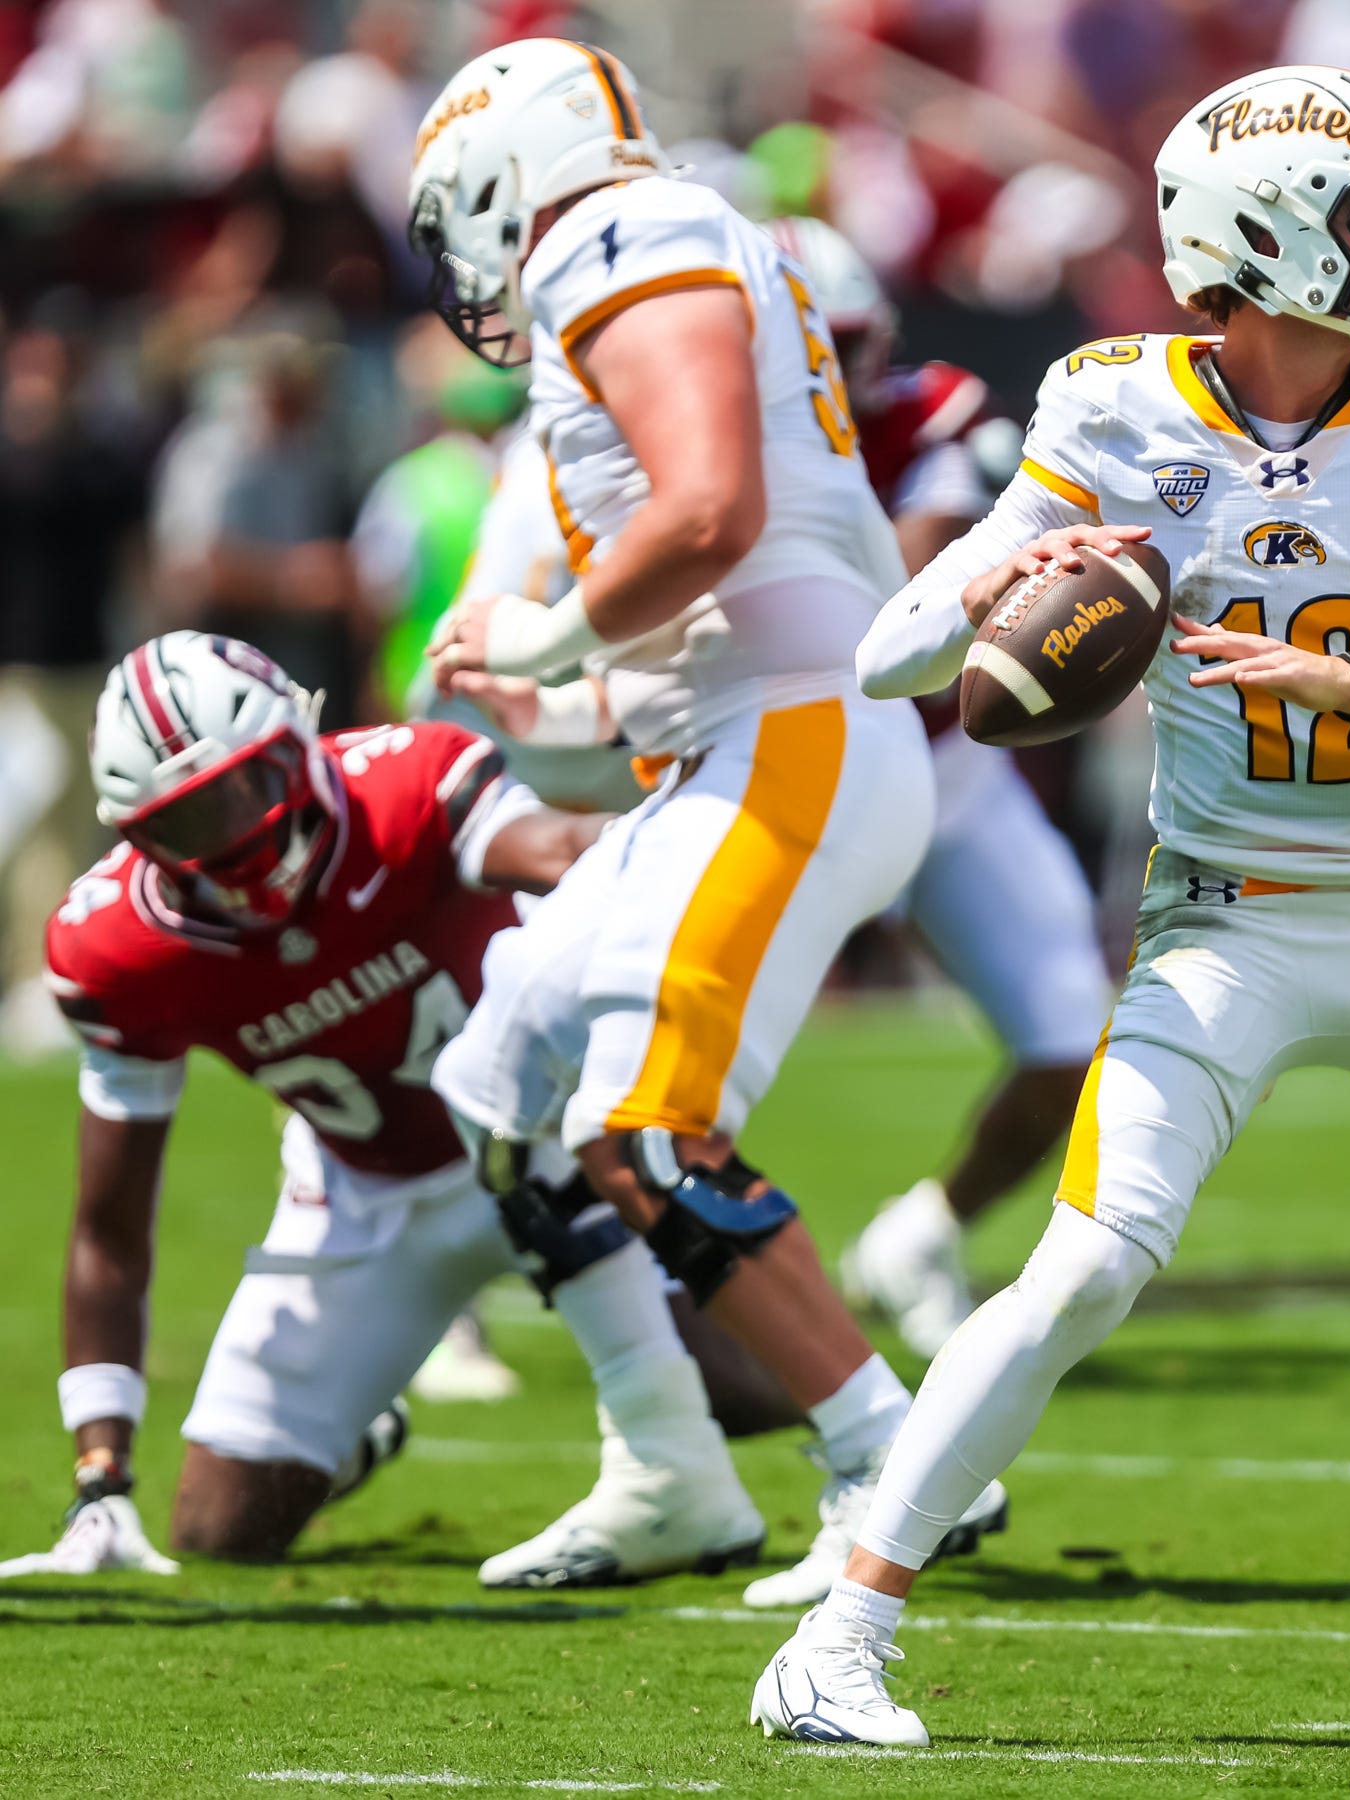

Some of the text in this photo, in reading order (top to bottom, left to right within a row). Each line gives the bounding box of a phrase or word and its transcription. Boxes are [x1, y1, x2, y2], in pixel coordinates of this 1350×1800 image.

[1157, 479, 1207, 494] MAC
[1263, 531, 1304, 566] K
[1040, 595, 1129, 670] Flashes
[237, 940, 431, 1057] CAROLINA
